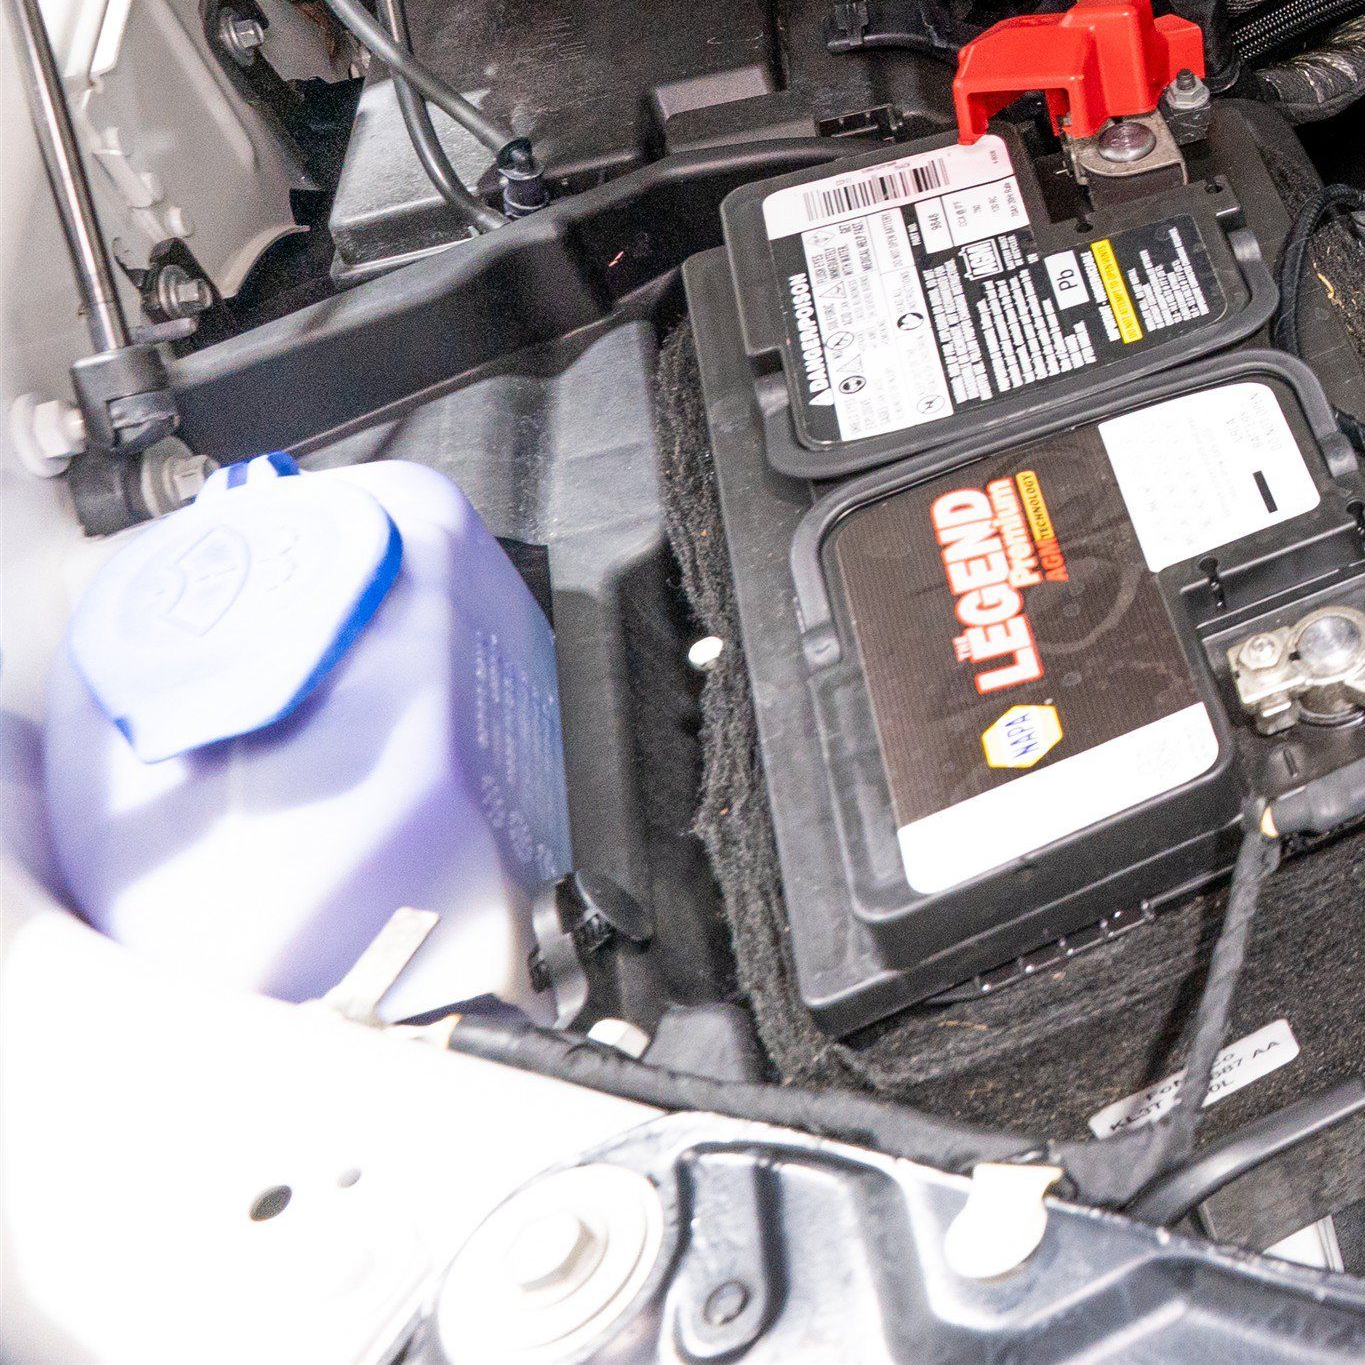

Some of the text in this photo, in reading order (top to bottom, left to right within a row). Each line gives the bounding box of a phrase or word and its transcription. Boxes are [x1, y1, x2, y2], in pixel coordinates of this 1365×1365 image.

[838, 223, 851, 234] GET
[927, 211, 943, 231] 9848
[854, 234, 867, 248] HELP
[811, 253, 826, 284] FLUSH EYES
[824, 246, 841, 280] IMMEDIATELY
[842, 262, 854, 276] WITH
[858, 247, 873, 271] MEDICAL
[966, 242, 998, 276] AGM
[1054, 267, 1077, 291] Pb
[787, 272, 829, 393] DANGER/POISON
[986, 475, 1042, 588] Premium
[1021, 469, 1069, 580] AGM TECHNOLOGY
[928, 480, 1044, 692] LEGEND
[1003, 712, 1039, 759] NAPA
